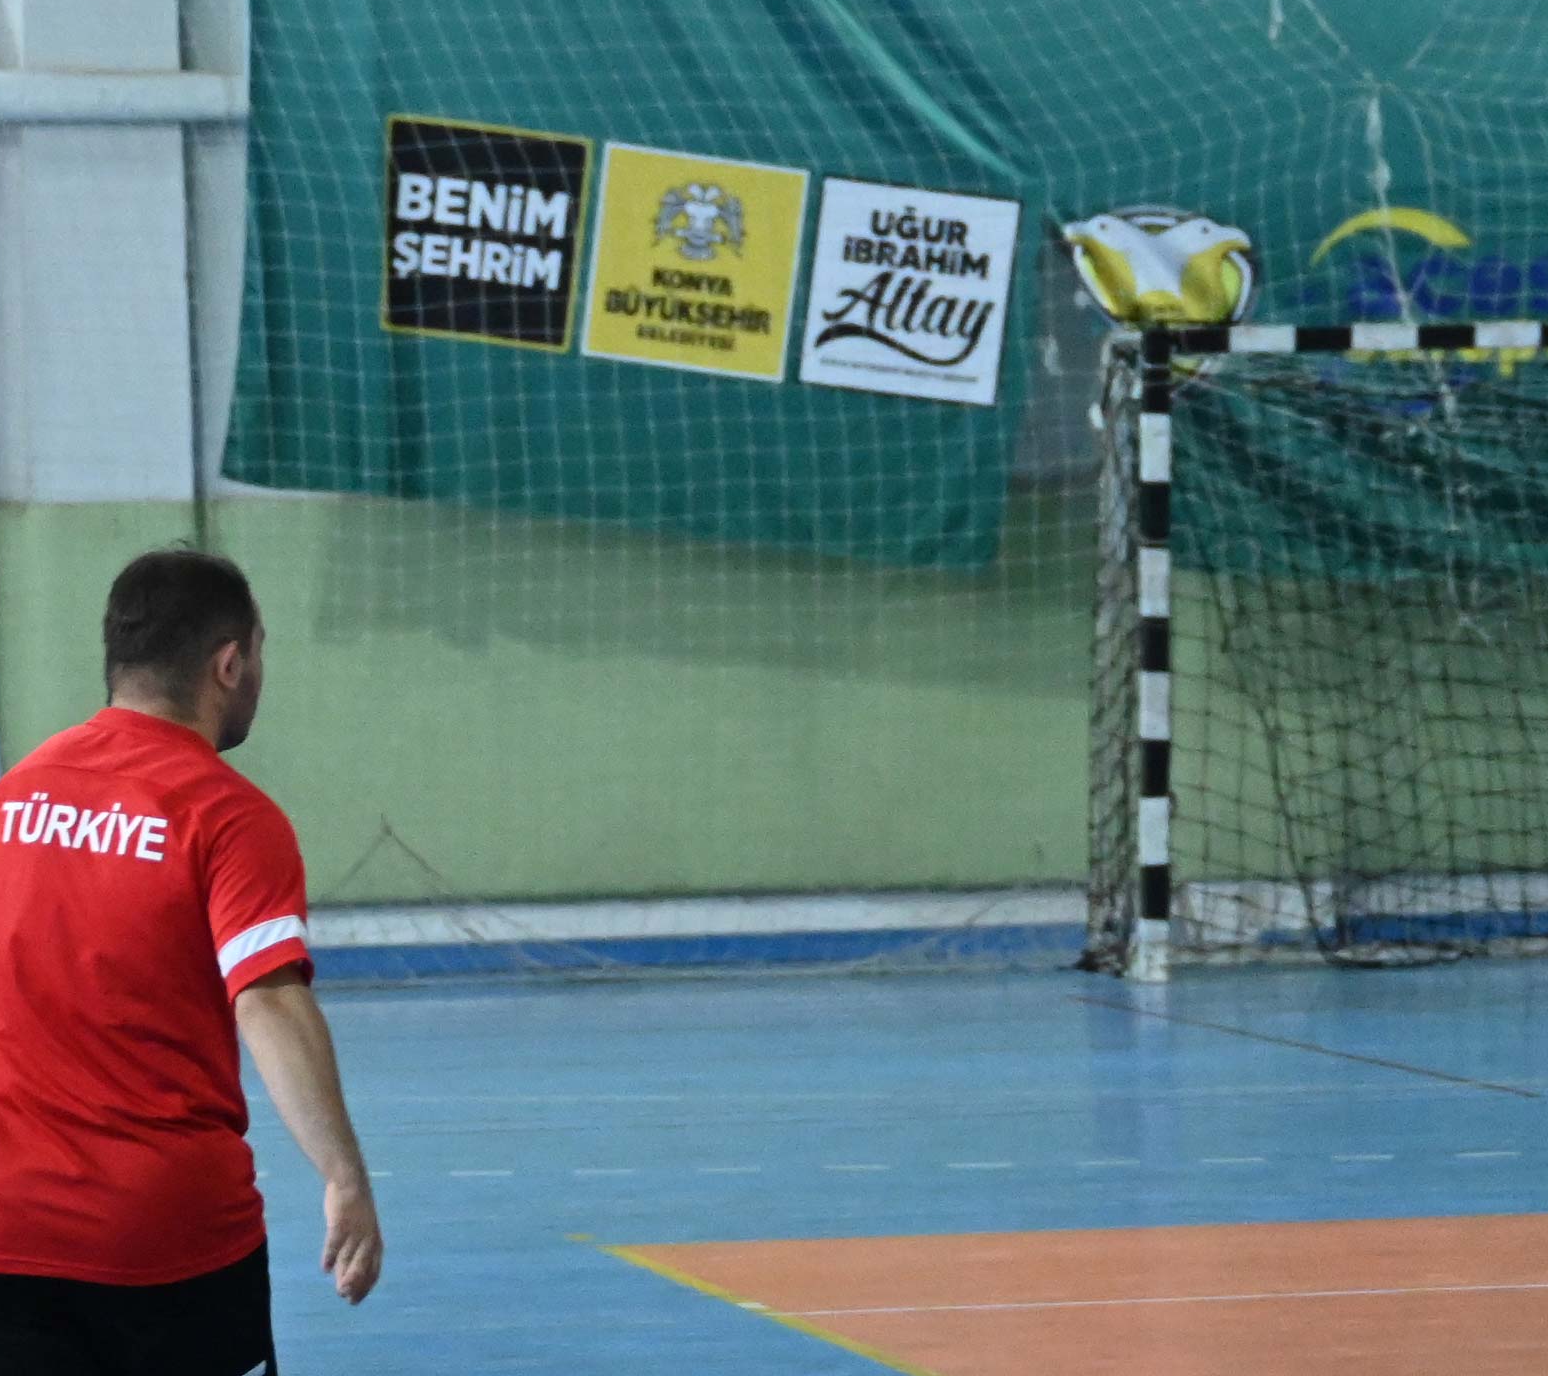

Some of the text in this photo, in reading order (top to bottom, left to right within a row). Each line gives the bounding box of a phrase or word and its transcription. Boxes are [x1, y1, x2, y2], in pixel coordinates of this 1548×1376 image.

[396, 173, 570, 240] BENİM
[870, 205, 969, 247] UĞUR
[392, 231, 562, 291] ŞEHRİM
[815, 271, 995, 366] Altay
[1, 792, 168, 863] TÜRKİYE
